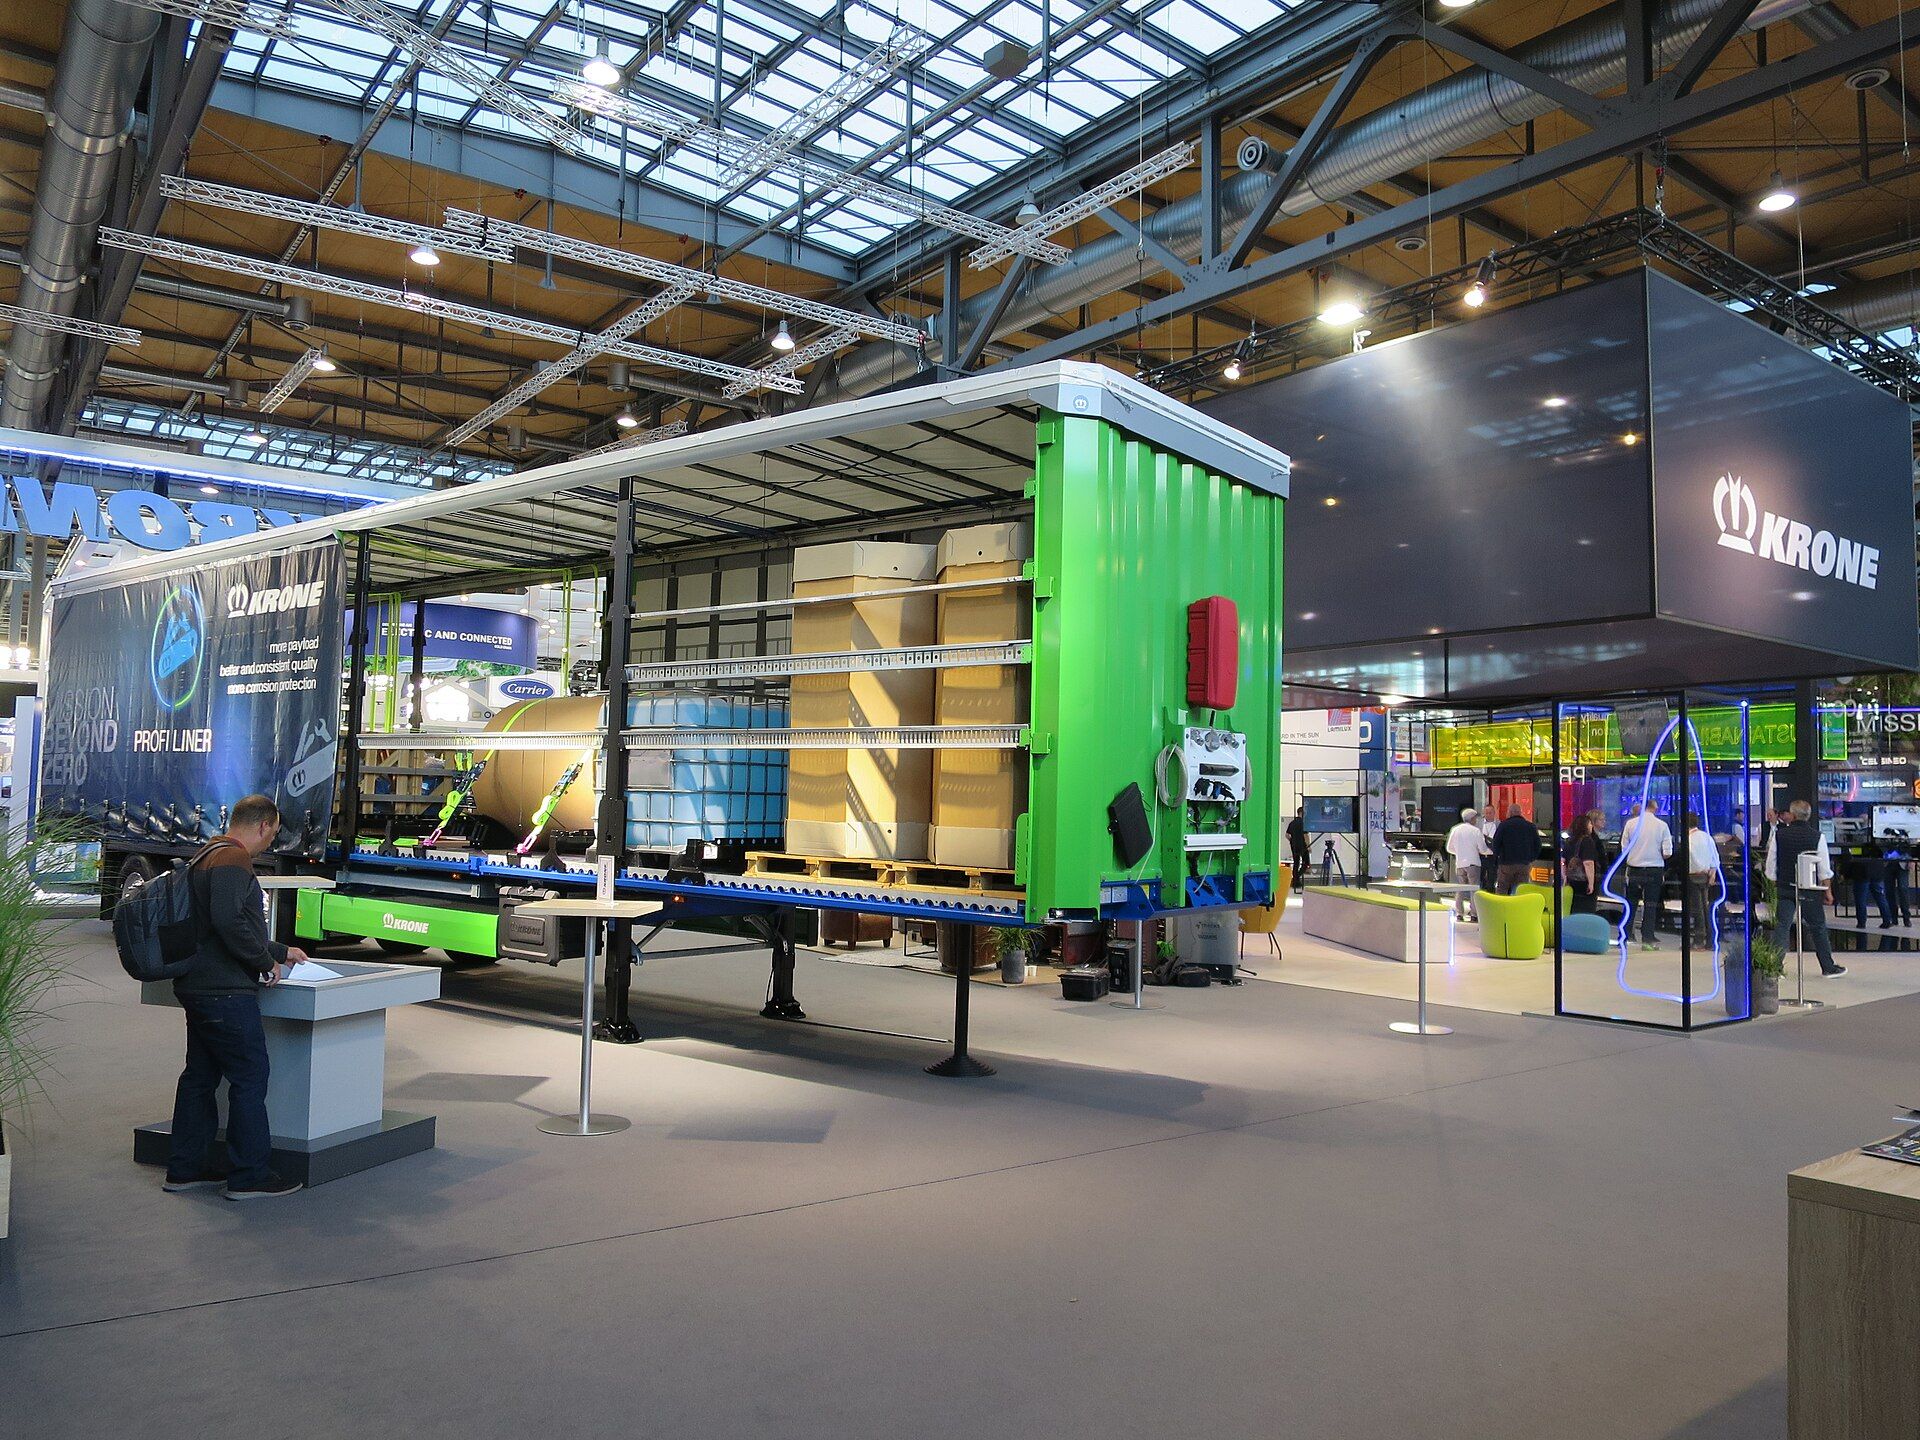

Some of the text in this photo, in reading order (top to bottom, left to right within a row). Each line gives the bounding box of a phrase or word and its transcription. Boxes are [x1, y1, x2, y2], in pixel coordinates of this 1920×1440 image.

[1758, 511, 1880, 590] KRONE
[246, 580, 325, 616] KRONE
[269, 635, 320, 654] more payload
[381, 627, 513, 646] ECTC AND CONNECTED
[219, 656, 319, 677] better and consistent quality
[227, 676, 317, 695] more corrosion protection
[507, 683, 550, 696] Carrier
[133, 729, 212, 753] PROFI LINER
[1308, 731, 1320, 739] SUN
[42, 752, 88, 786] ZERO
[1369, 810, 1393, 820] TRIPLE
[1369, 820, 1390, 830] PACK
[393, 919, 430, 934] KRONE
